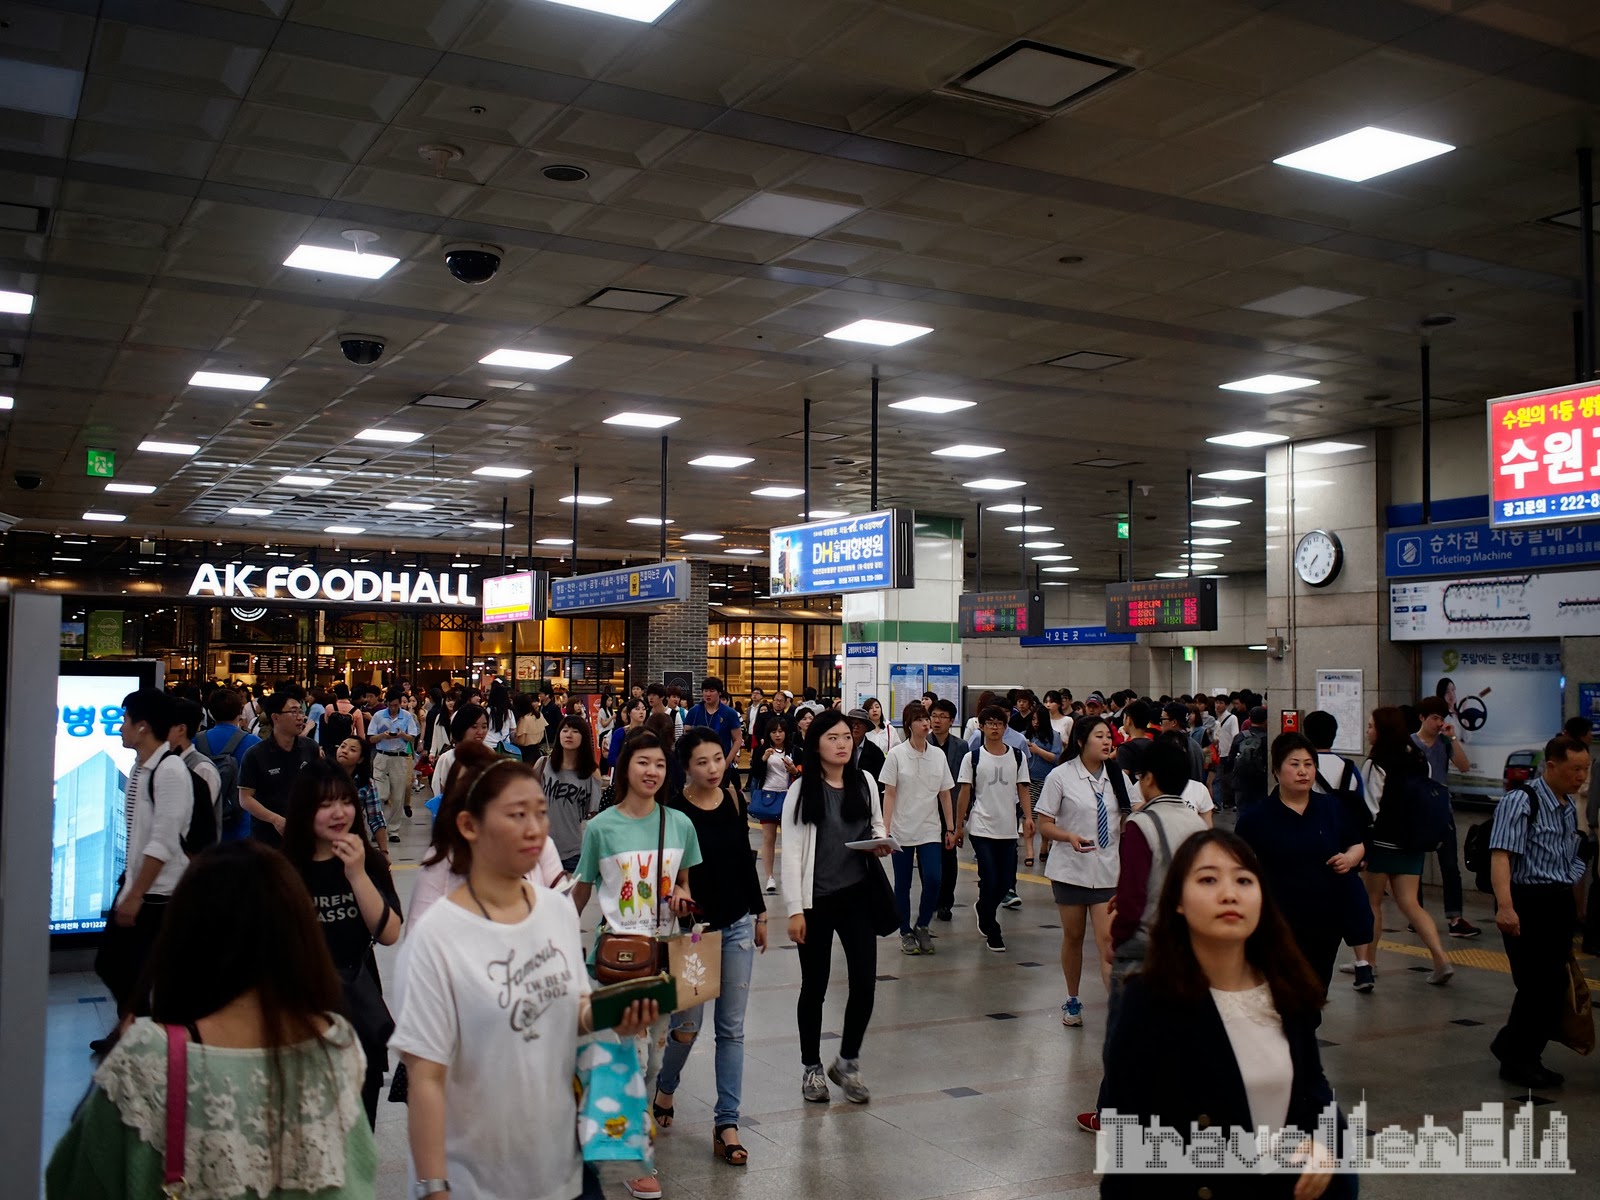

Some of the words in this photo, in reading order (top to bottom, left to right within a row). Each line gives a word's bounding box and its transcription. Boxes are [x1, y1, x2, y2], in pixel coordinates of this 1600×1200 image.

[1502, 405, 1546, 430] 수원의
[1503, 498, 1546, 517] 광고문의
[1560, 493, 1600, 511] 222-8
[812, 541, 833, 564] DH
[840, 534, 883, 561] 대항병원
[1430, 531, 1479, 553] 승차권
[1431, 554, 1471, 565] Ticketing
[1473, 550, 1513, 562] Machine
[188, 563, 256, 598] AK
[266, 567, 477, 606] FOODHALL
[96, 635, 119, 643] GRAND
[96, 642, 119, 650] OPEN
[1460, 653, 1497, 665] 주말에는
[1501, 652, 1540, 665] 운전대를
[57, 704, 126, 738] 병원
[487, 939, 568, 1009] Famous
[537, 985, 568, 1003] 1902
